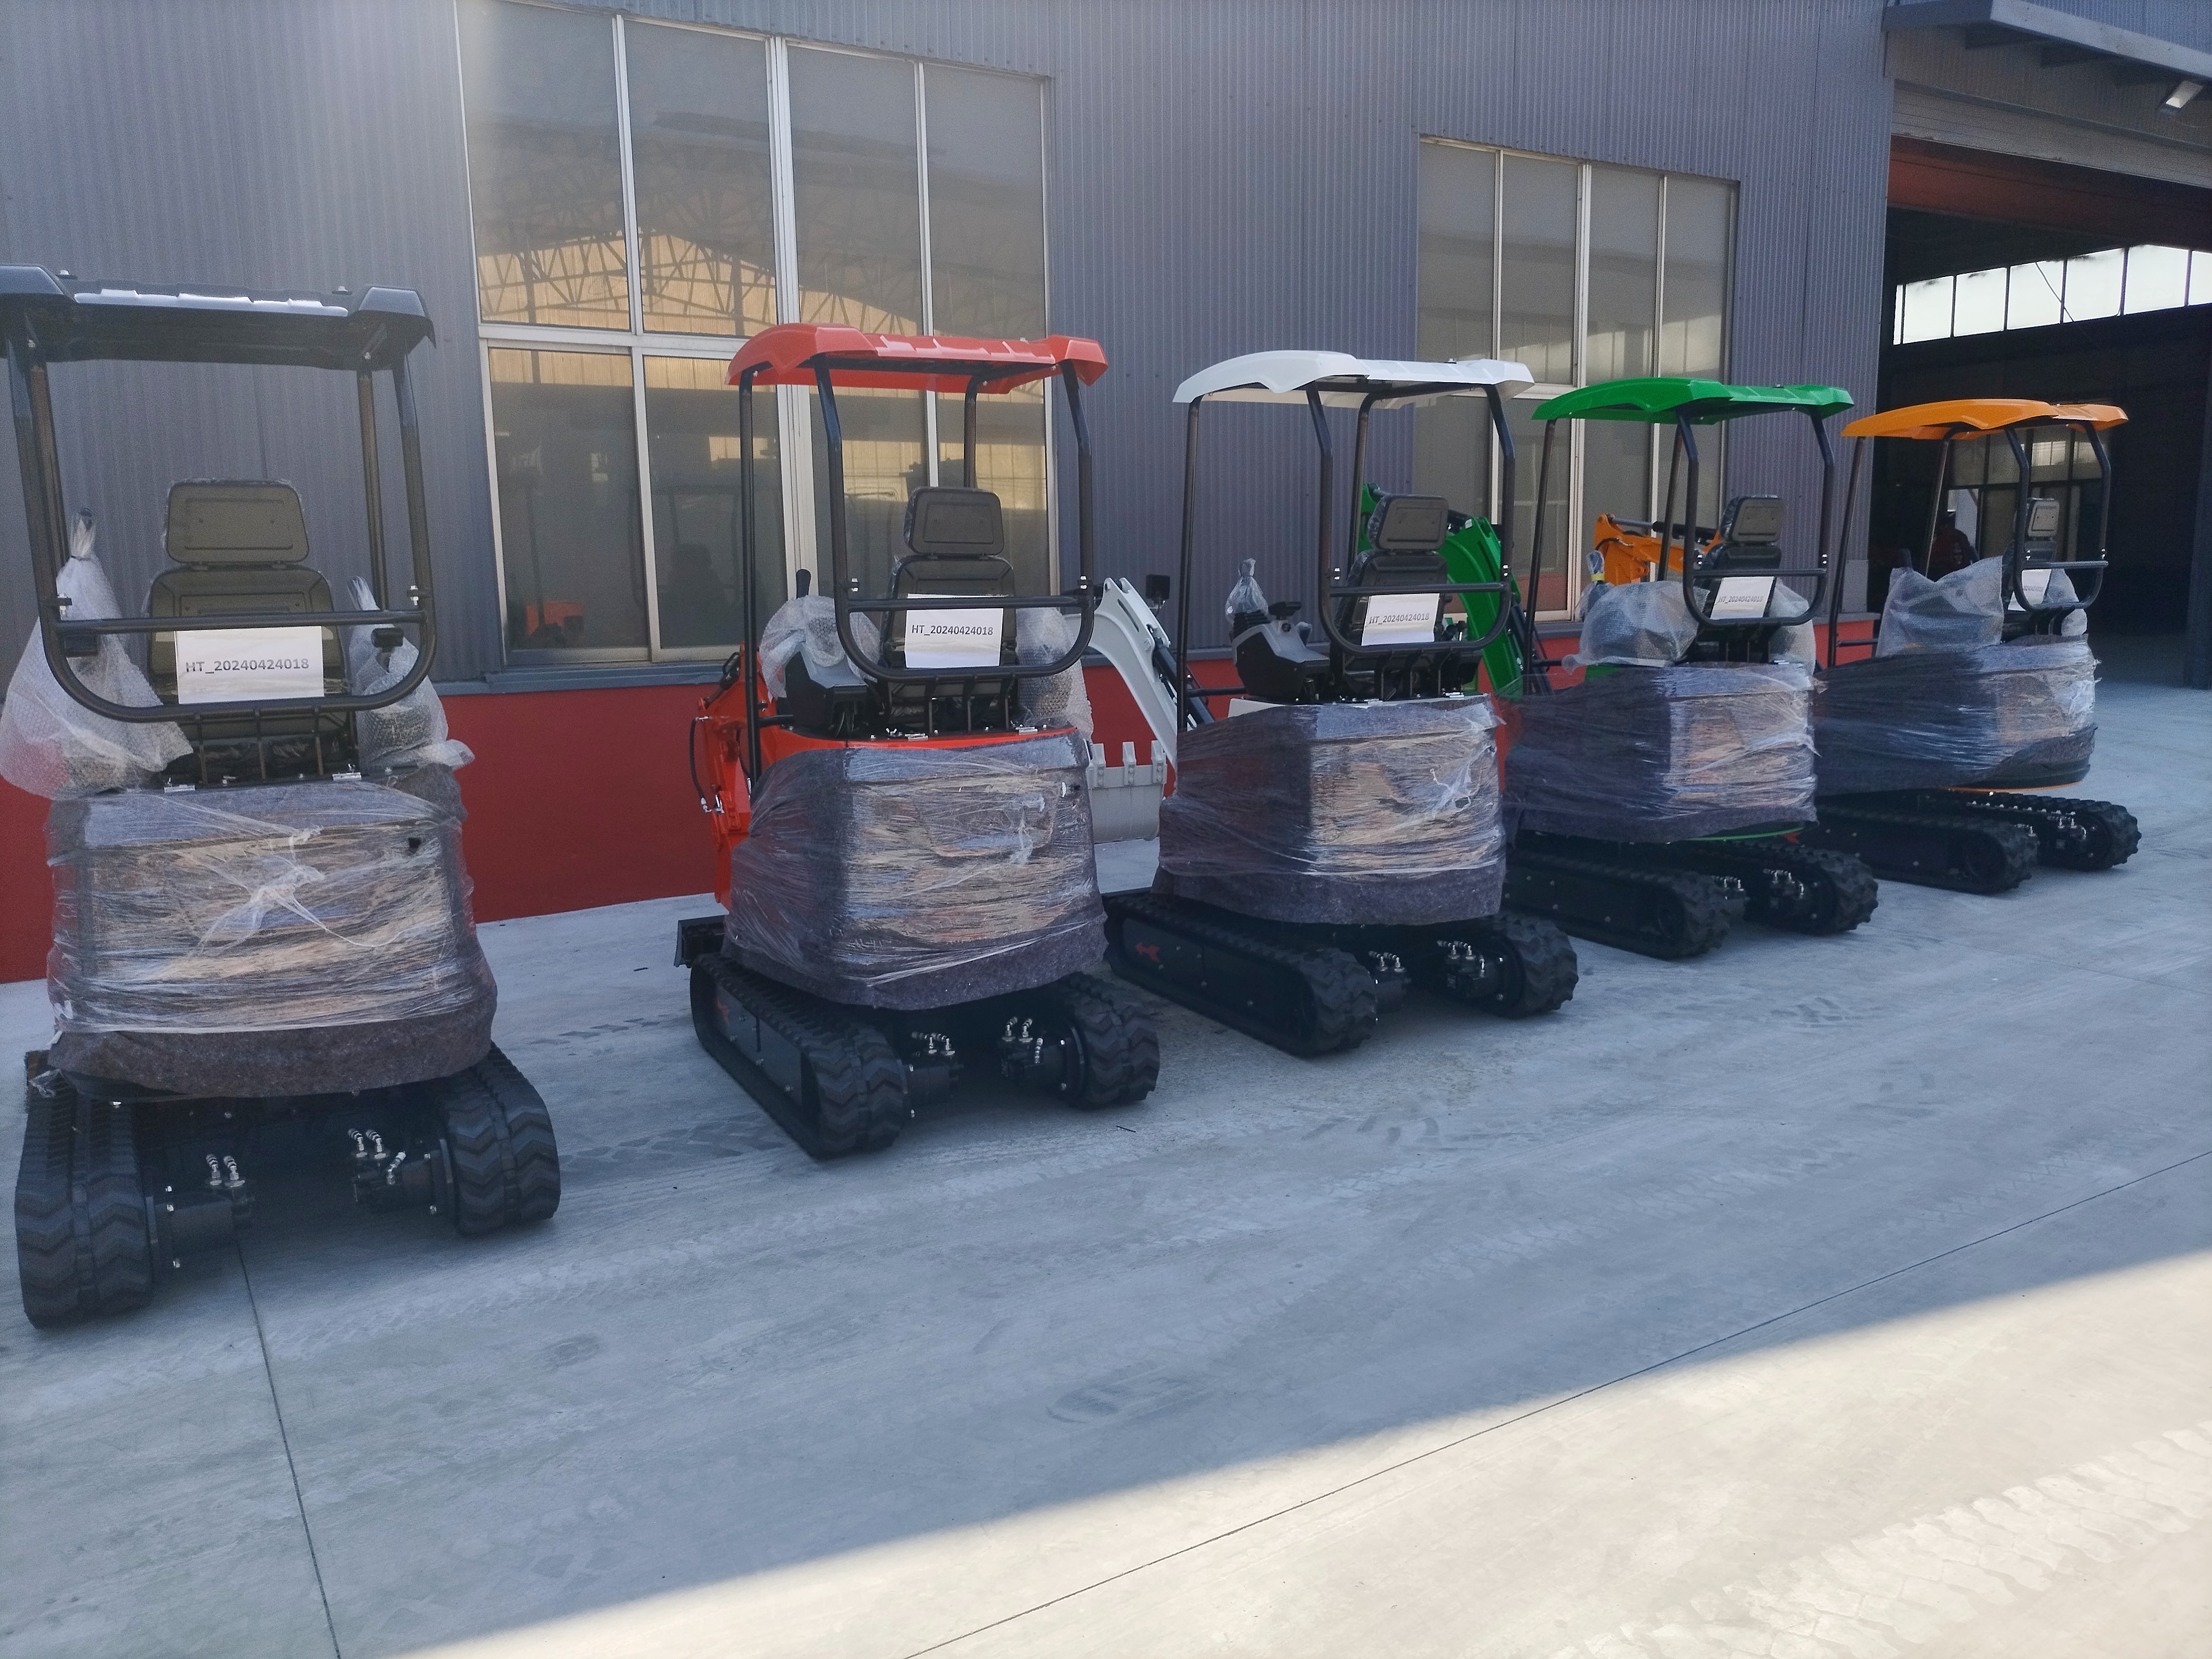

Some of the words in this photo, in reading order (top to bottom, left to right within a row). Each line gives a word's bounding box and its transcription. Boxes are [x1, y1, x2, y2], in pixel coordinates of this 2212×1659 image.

[1369, 613, 1430, 625] HT_20240424018
[912, 625, 993, 636] HT_20240424018
[186, 659, 309, 674] HT_20240424018
